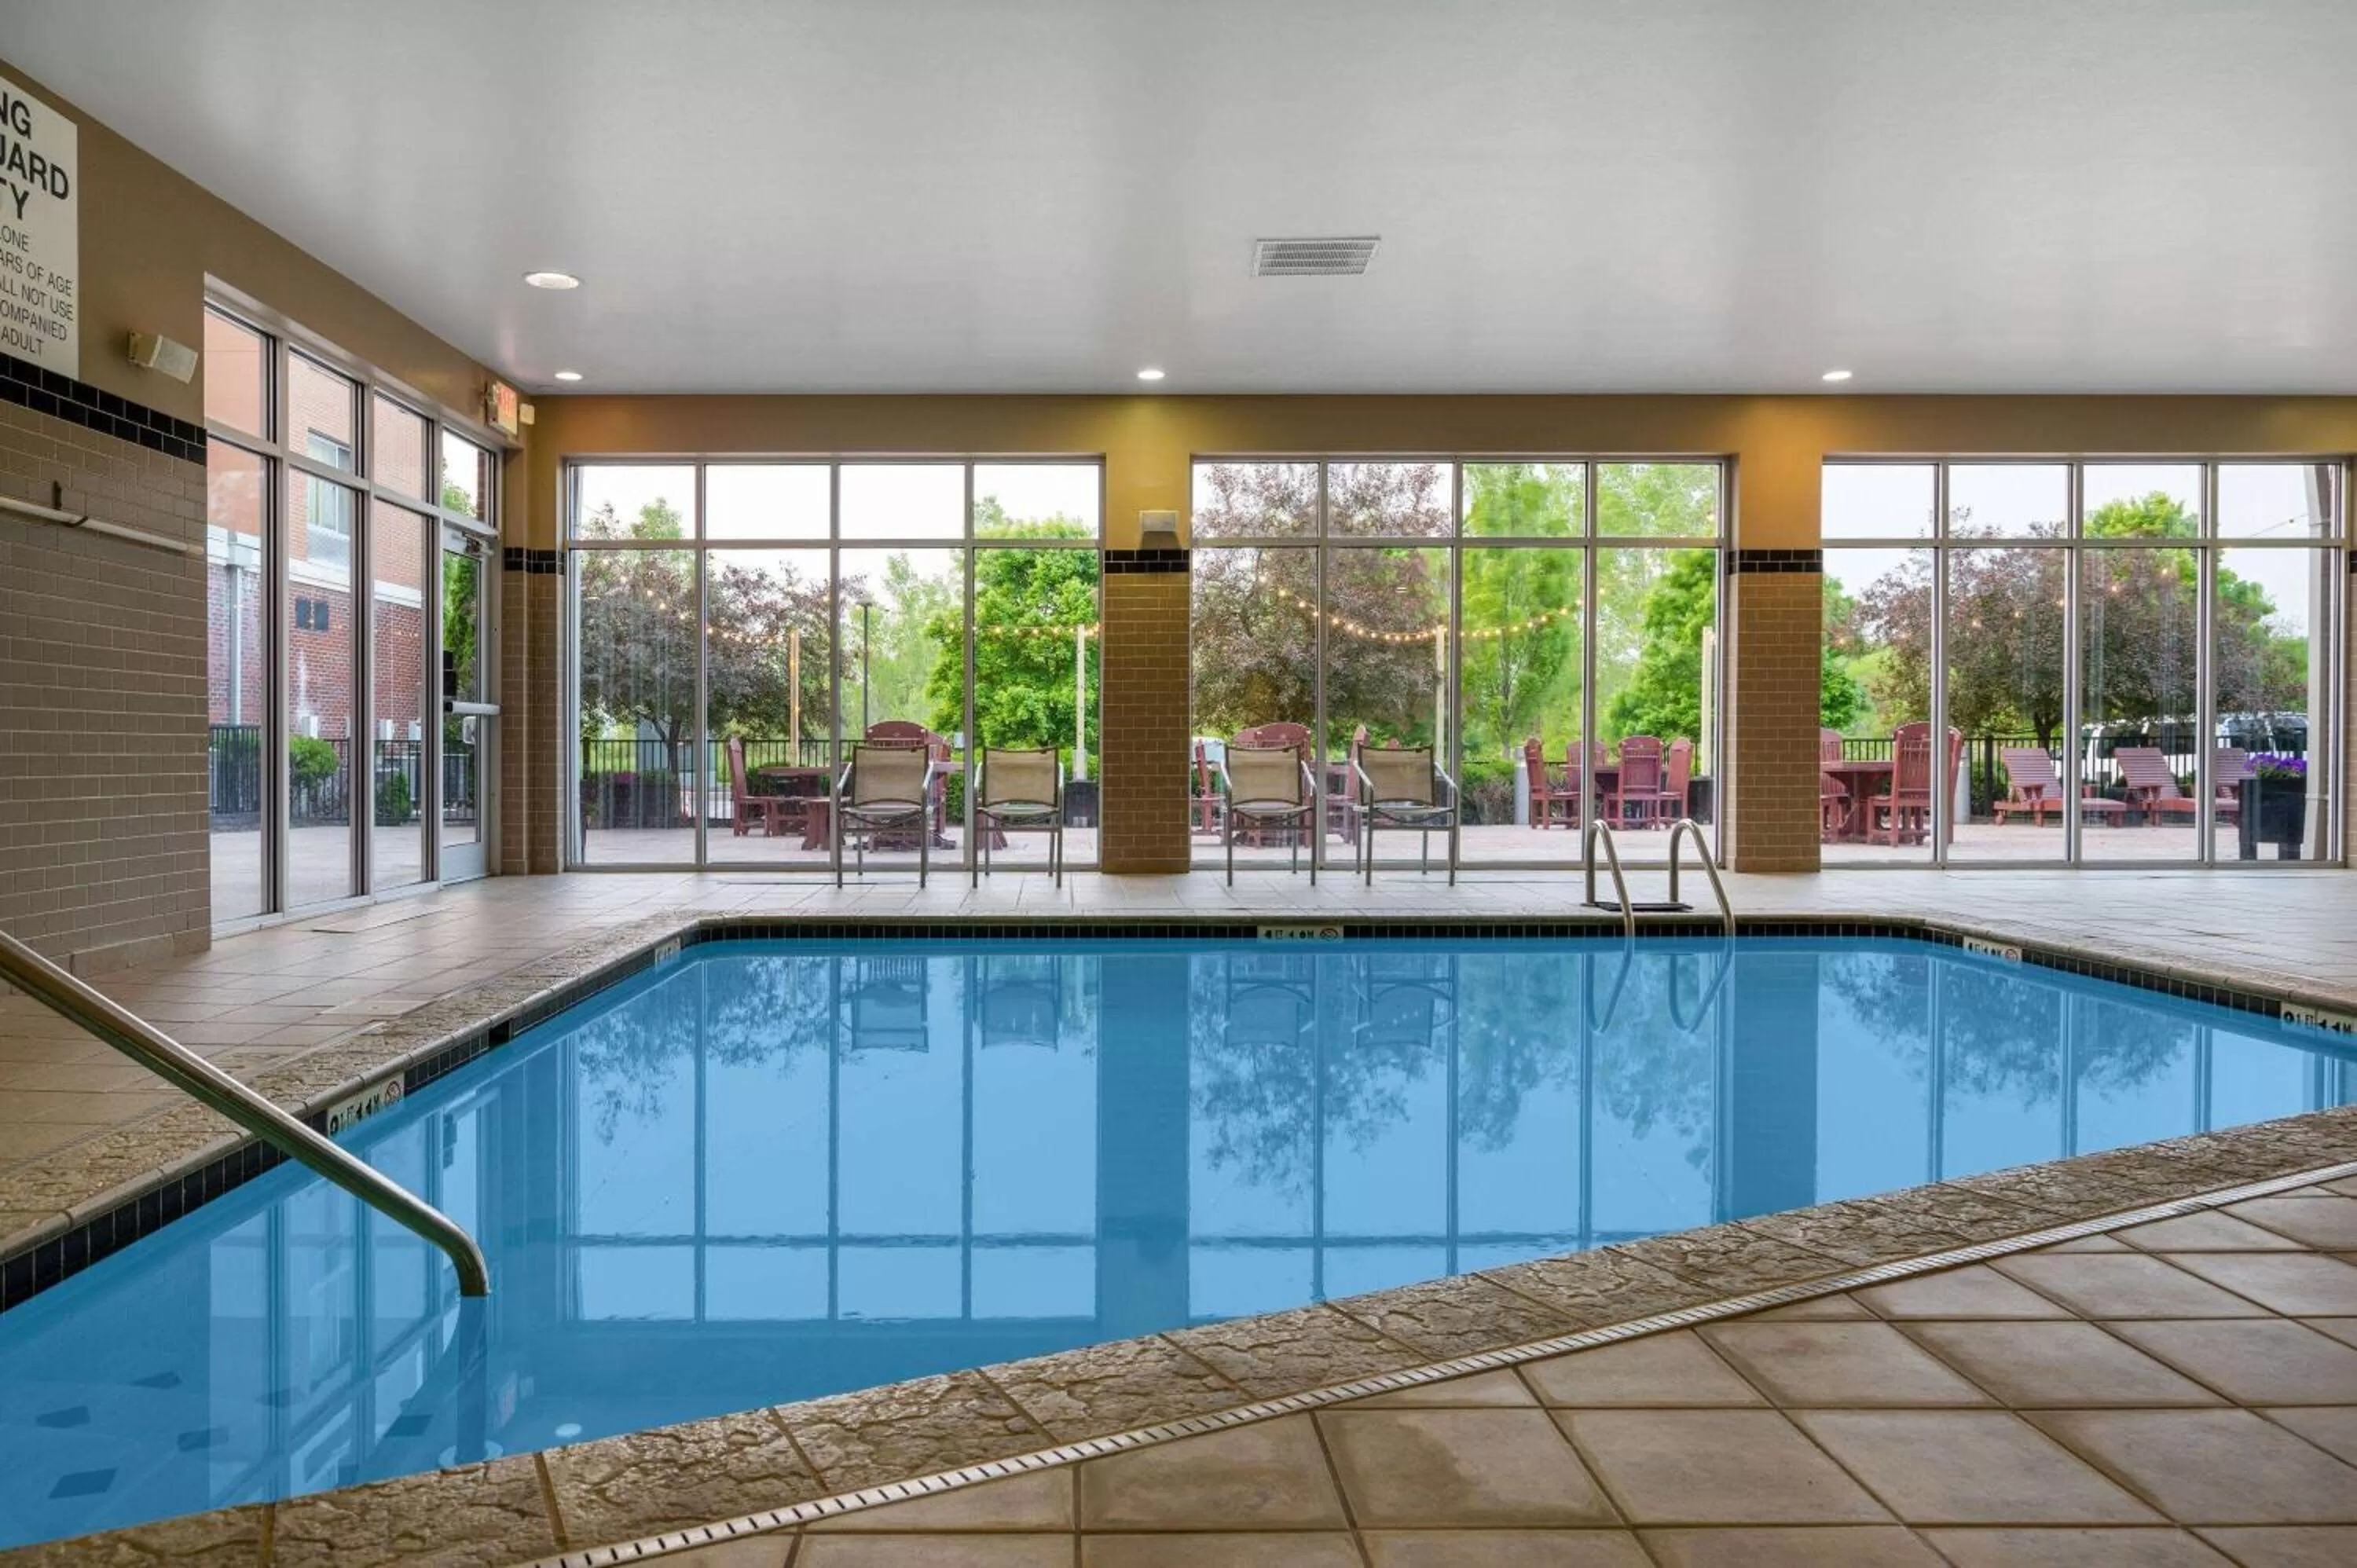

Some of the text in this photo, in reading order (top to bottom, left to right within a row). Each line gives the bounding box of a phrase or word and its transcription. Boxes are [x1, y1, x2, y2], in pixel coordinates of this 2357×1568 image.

[27, 262, 44, 283] OF
[47, 272, 72, 298] AGE
[22, 284, 47, 309] NOT
[50, 295, 74, 321] USE
[2, 325, 44, 358] ADULT
